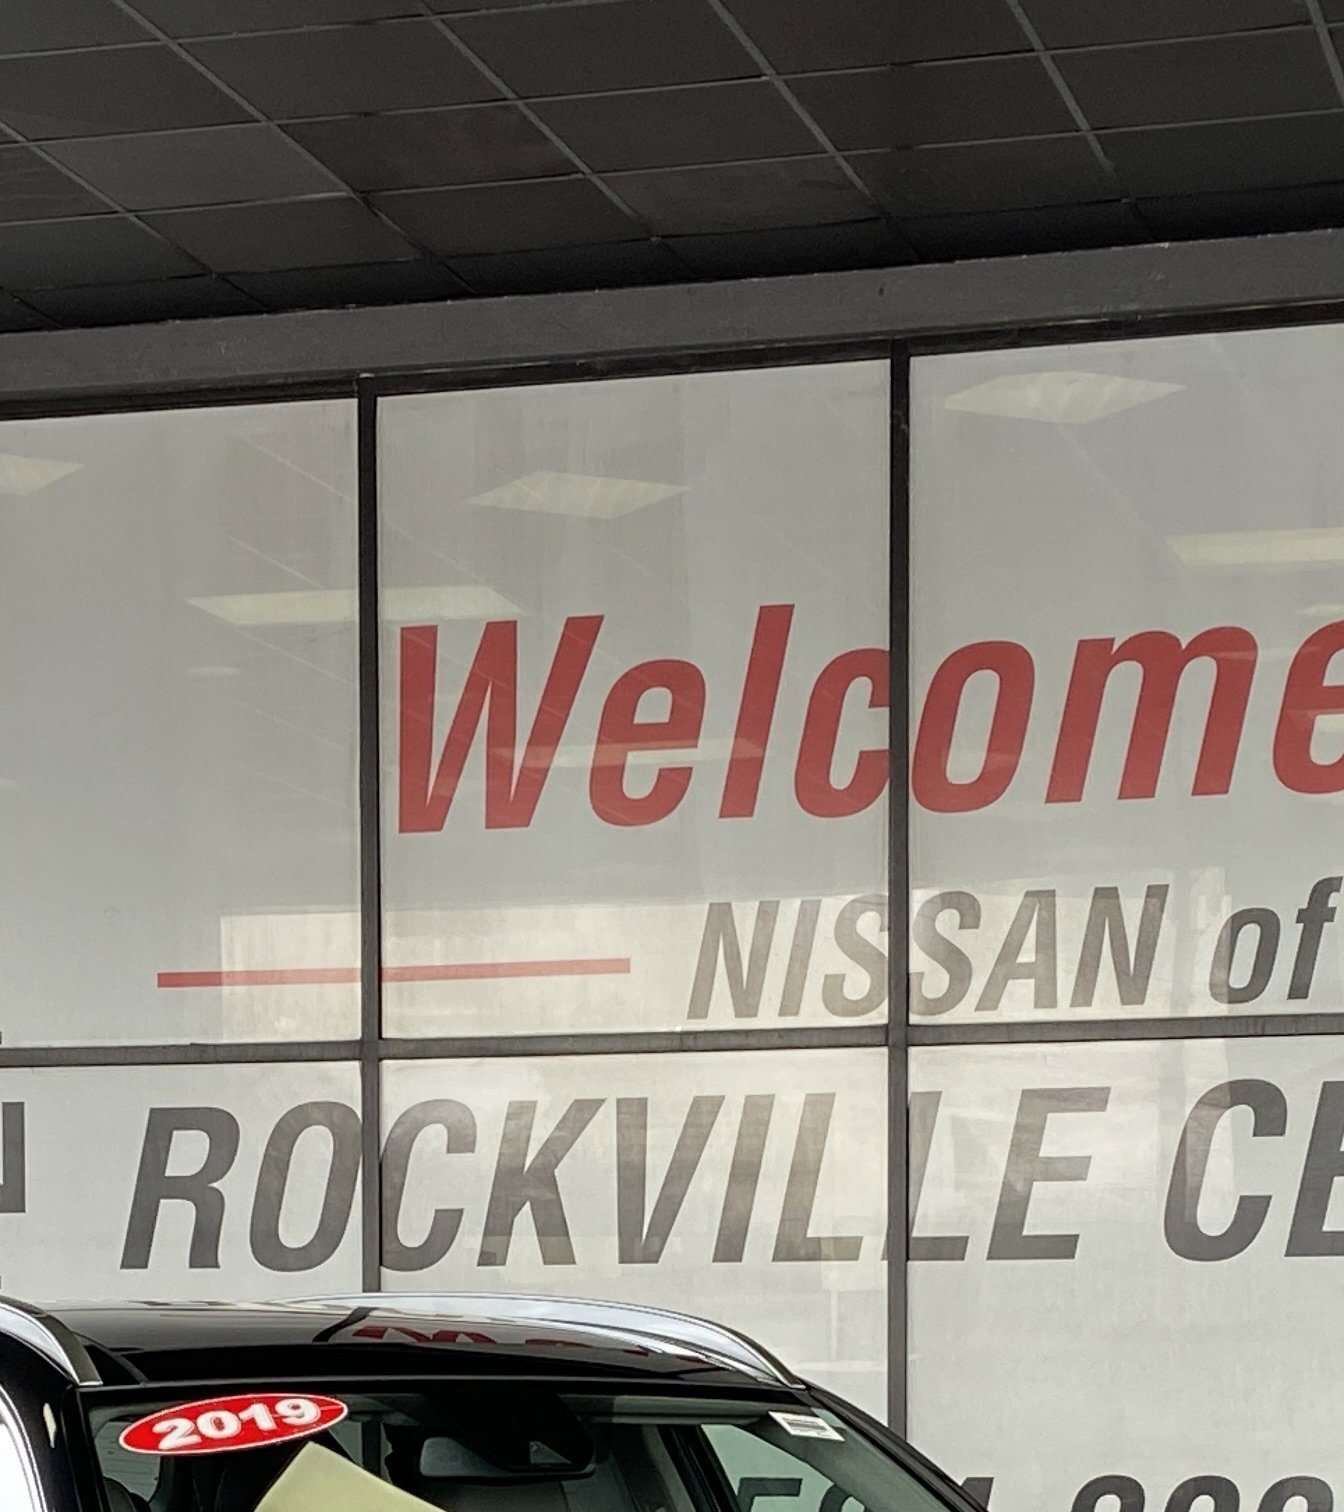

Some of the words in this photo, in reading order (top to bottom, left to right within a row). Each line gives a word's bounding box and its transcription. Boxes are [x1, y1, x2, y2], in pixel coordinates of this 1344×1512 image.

[685, 884, 1169, 1019] NISSAN
[1206, 877, 1343, 1006] of
[120, 1084, 1111, 1271] ROCKVILLE
[152, 1398, 322, 1450] 2019
